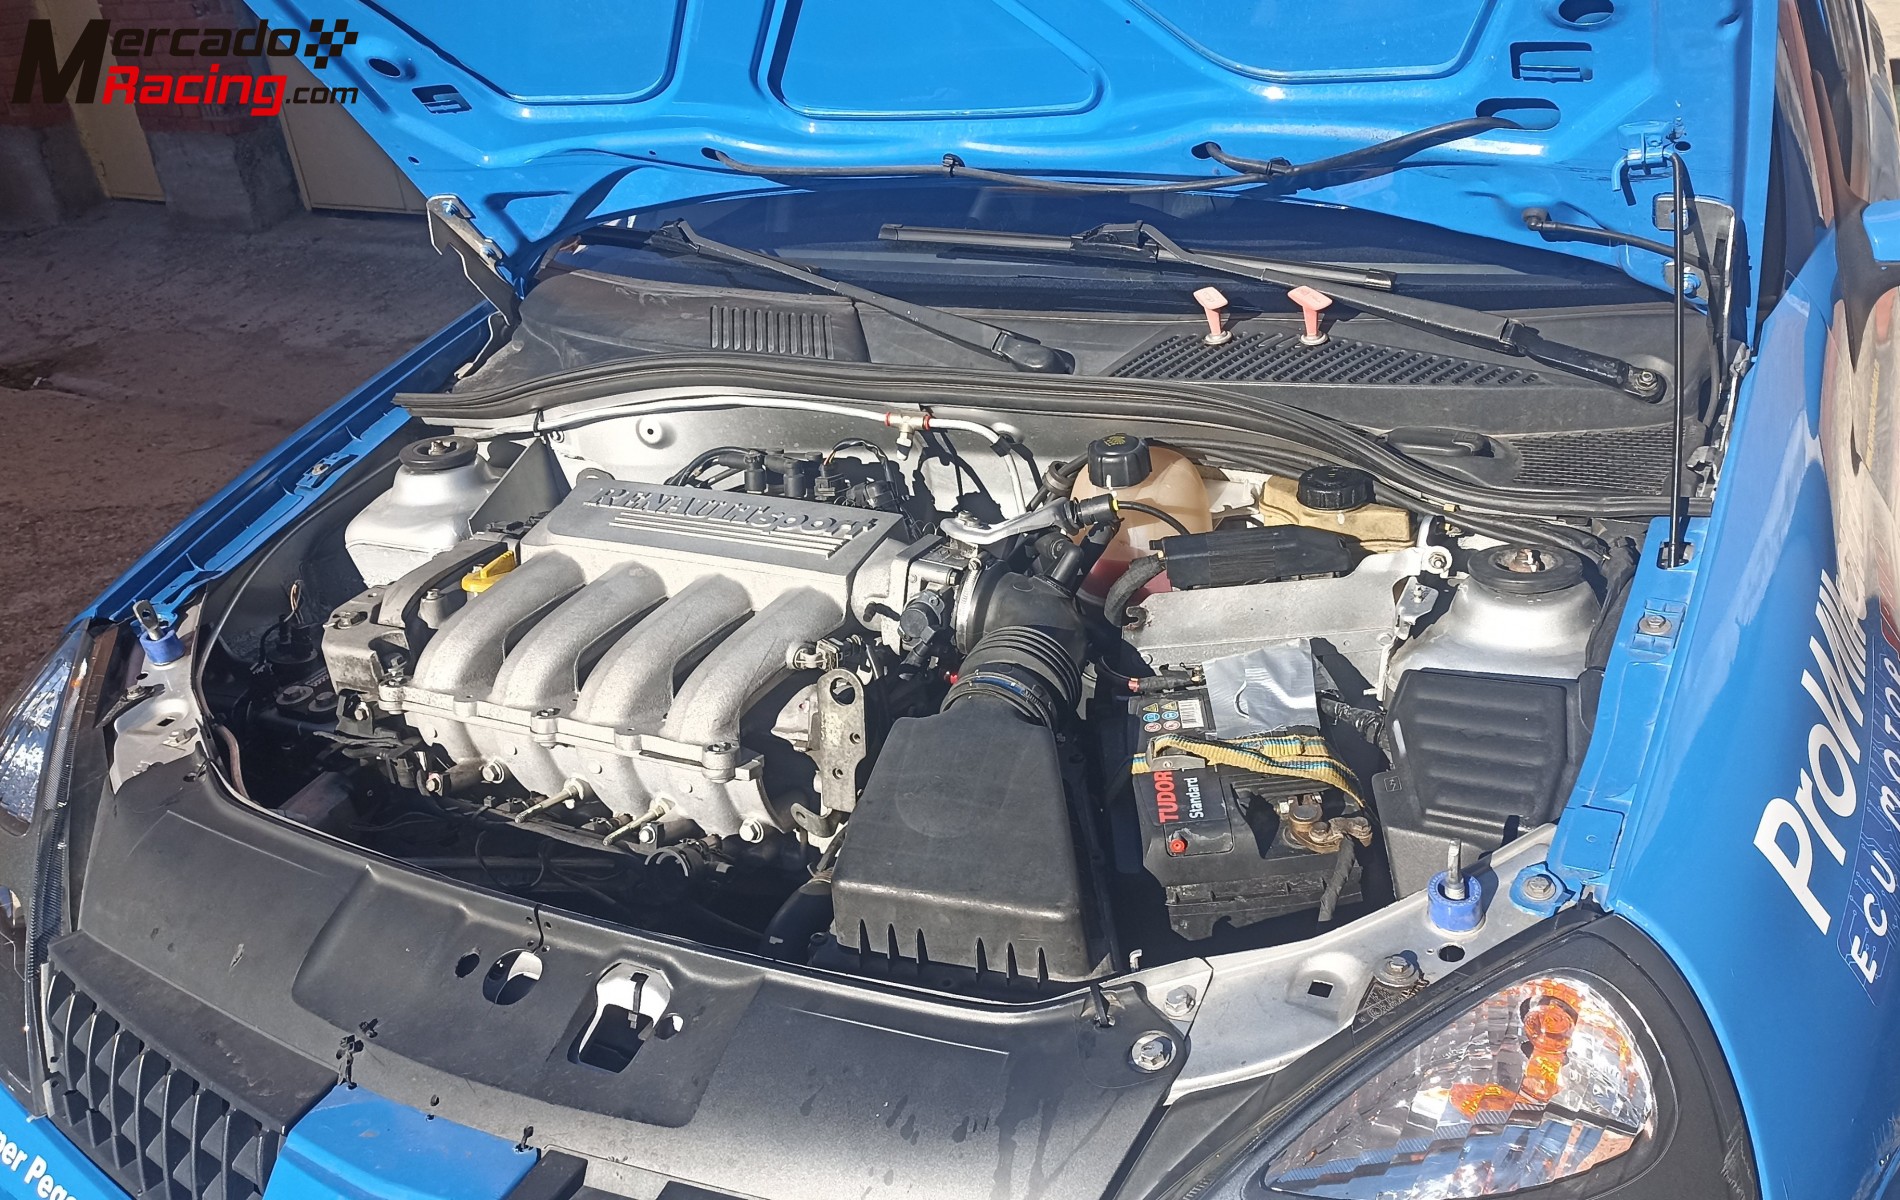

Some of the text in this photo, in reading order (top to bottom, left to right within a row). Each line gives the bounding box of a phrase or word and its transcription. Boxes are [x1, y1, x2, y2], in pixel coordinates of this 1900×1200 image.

[1153, 770, 1180, 823] TUDOR
[1184, 777, 1204, 819] Standard
[1850, 849, 1896, 984] ECU
